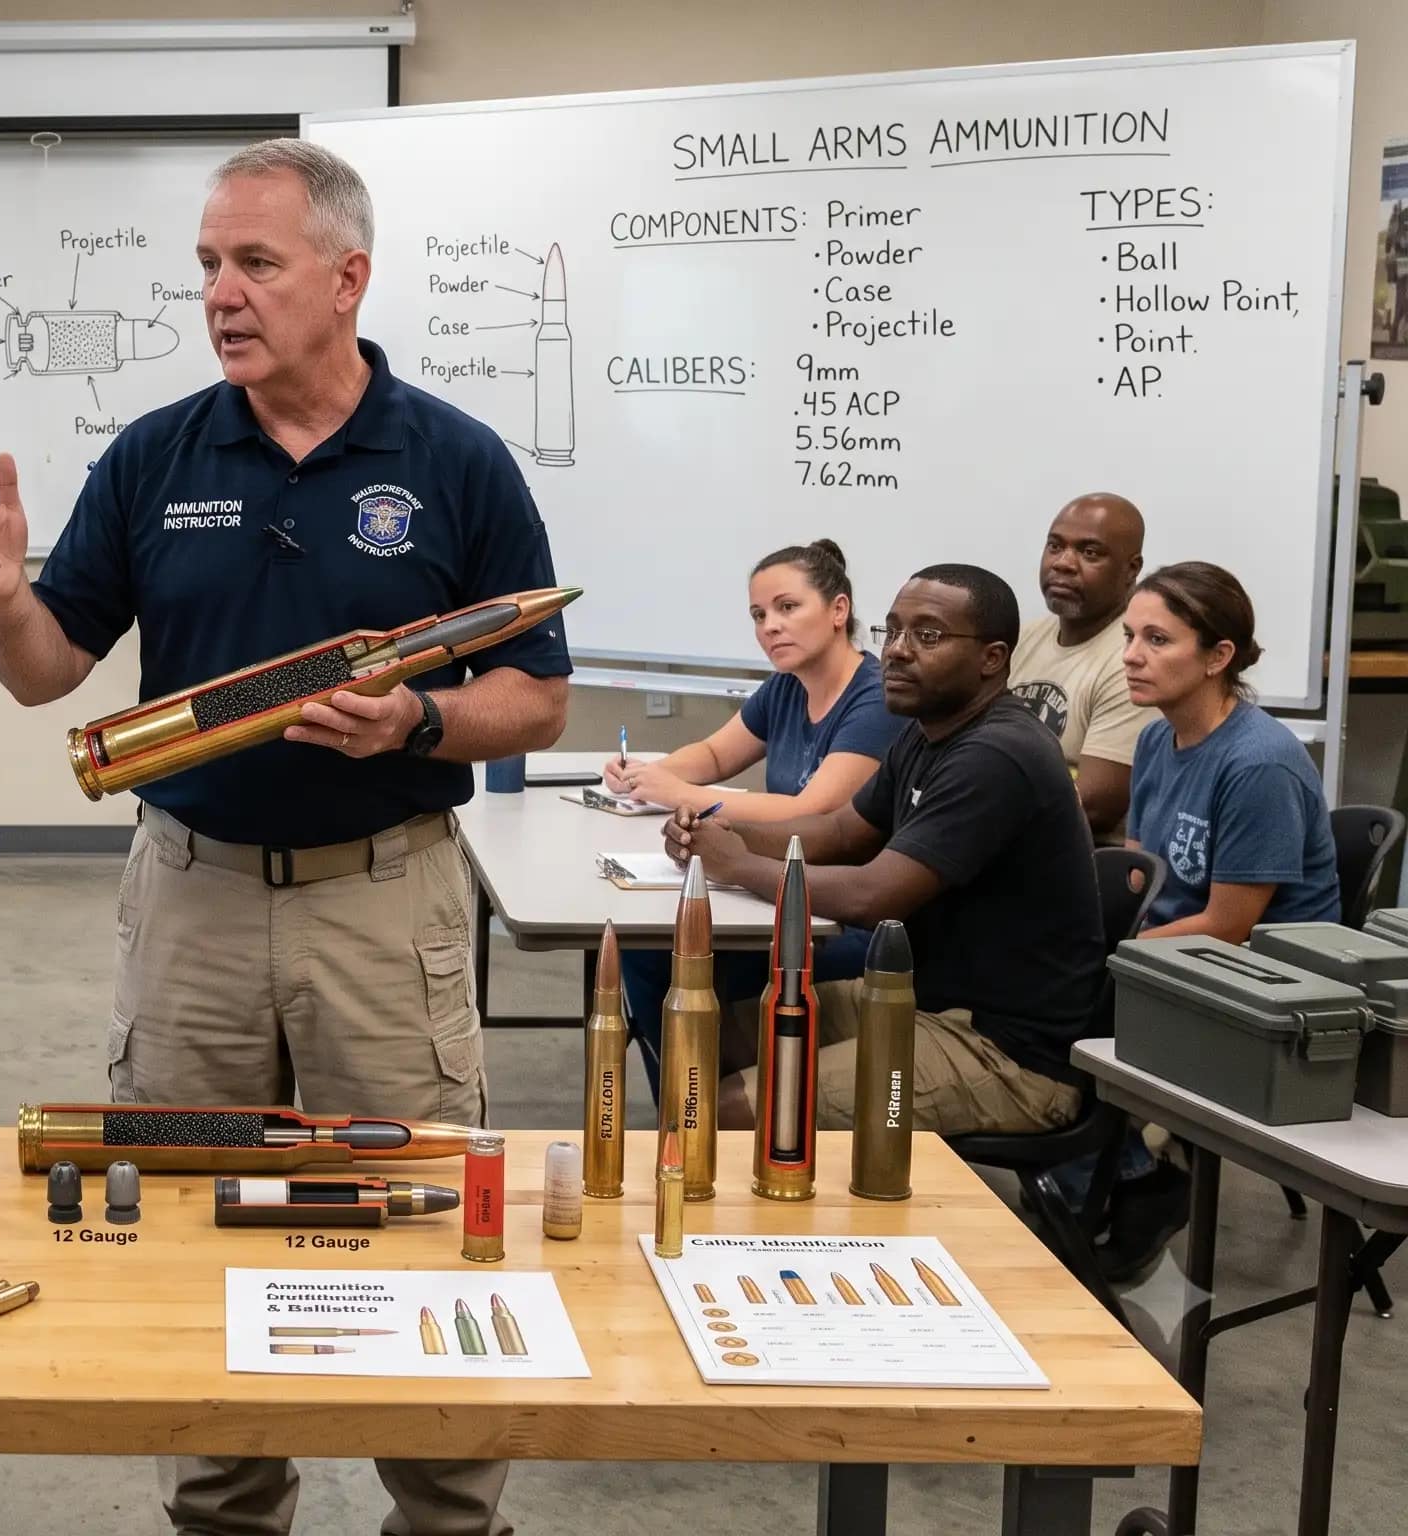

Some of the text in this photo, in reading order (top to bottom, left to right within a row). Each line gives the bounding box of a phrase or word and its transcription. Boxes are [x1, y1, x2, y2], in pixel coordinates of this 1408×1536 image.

[673, 107, 1169, 170] SMALL ARMS AMMUNITION
[1080, 186, 1214, 221] TYPES:
[610, 200, 922, 242] COMPONENTS: Primer
[60, 227, 148, 256] Projectile
[426, 233, 510, 262] Projectile
[826, 239, 923, 266] Powder
[1118, 241, 1177, 272] Ball
[429, 275, 489, 294] Powder
[825, 276, 893, 303] Case
[1115, 279, 1300, 318] Hollow Point,
[428, 316, 470, 336] Case
[826, 308, 957, 346] Projectile
[421, 357, 497, 383] Projectile
[607, 353, 860, 386] CALIBERS: 9mm
[793, 391, 901, 416] .45 ACP
[795, 425, 902, 452] 5.56mm
[794, 460, 899, 490] 7.62mm
[164, 500, 243, 515] AMMUNITION
[163, 515, 242, 530] INSTRUCTOR
[53, 1229, 139, 1247] 12 Gauge
[284, 1235, 371, 1252] 12 Gauge
[265, 1282, 385, 1292] Ammunition
[266, 1304, 281, 1314] &
